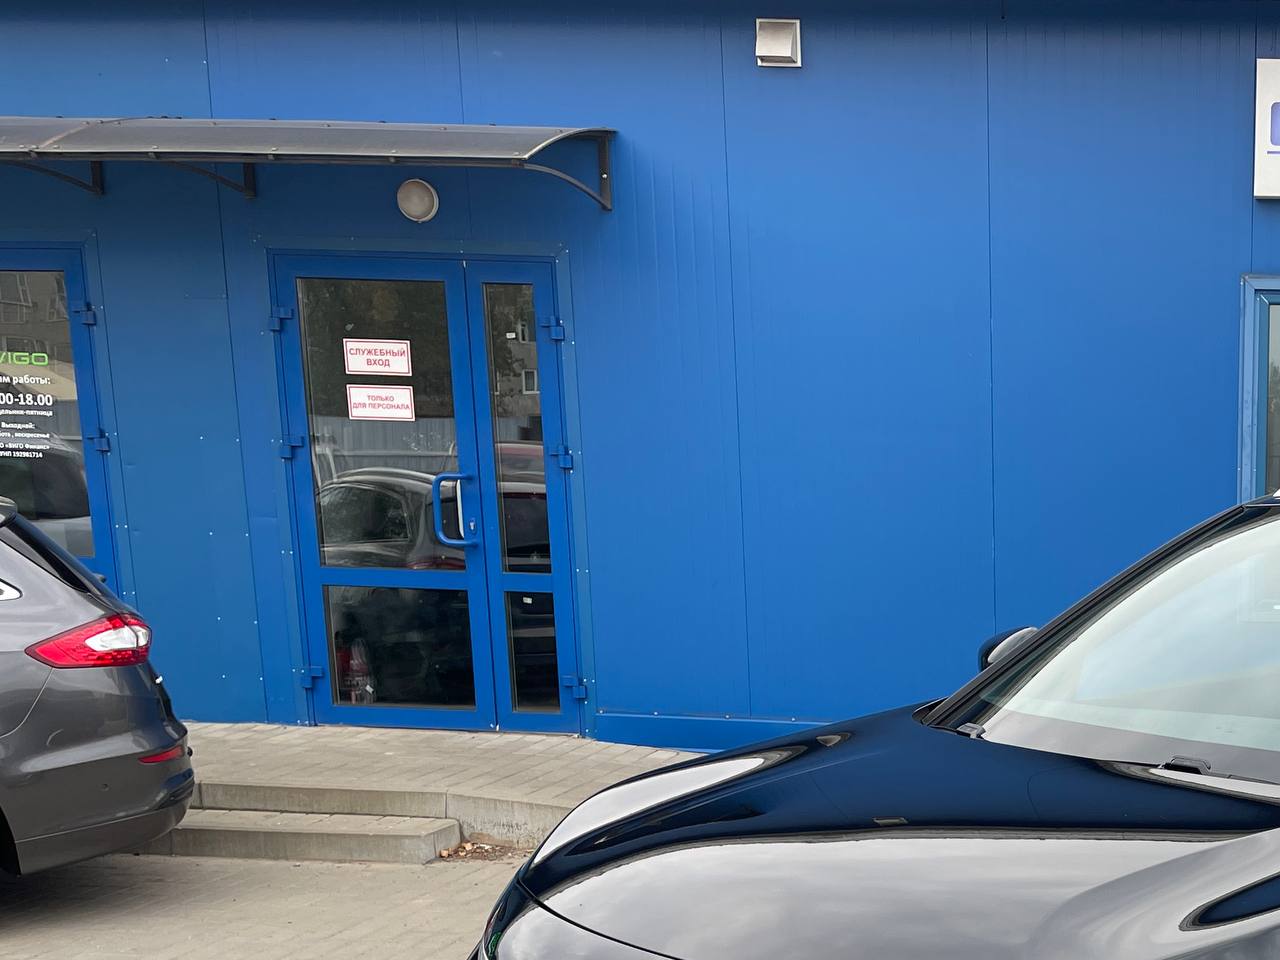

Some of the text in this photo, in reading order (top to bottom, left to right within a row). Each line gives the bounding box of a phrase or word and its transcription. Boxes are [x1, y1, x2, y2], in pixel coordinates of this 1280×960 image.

[348, 347, 406, 357] СЛУЖЕБНЫЙ
[366, 358, 391, 368] ВХОД
[12, 374, 51, 386] работы:
[367, 394, 395, 402] ТОЛЬКО
[352, 402, 367, 410] ДЛЯ
